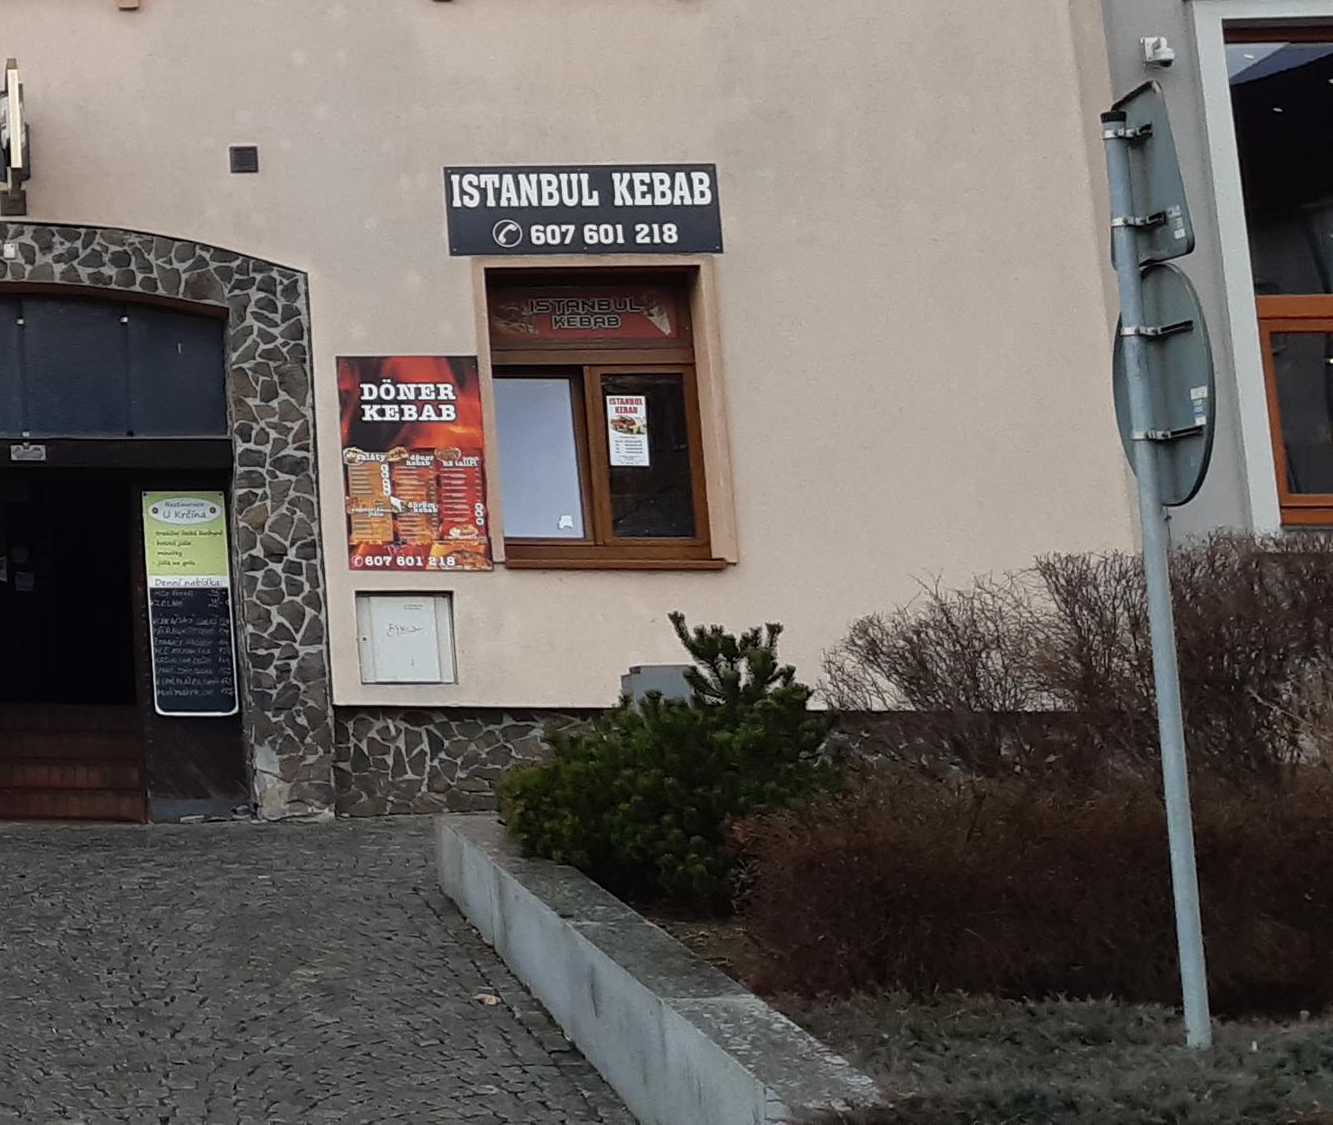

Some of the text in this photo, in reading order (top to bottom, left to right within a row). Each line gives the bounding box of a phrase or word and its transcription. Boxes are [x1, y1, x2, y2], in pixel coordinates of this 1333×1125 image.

[450, 171, 712, 208] ISTANBUL KEBAB
[530, 223, 679, 245] 607 601 218
[529, 297, 645, 315] ISTANBUL
[552, 315, 621, 329] KEBAB
[359, 378, 457, 401] DÖNER
[360, 404, 457, 422] KEBAB
[163, 510, 171, 519] U
[364, 556, 455, 566] 607 601 218
